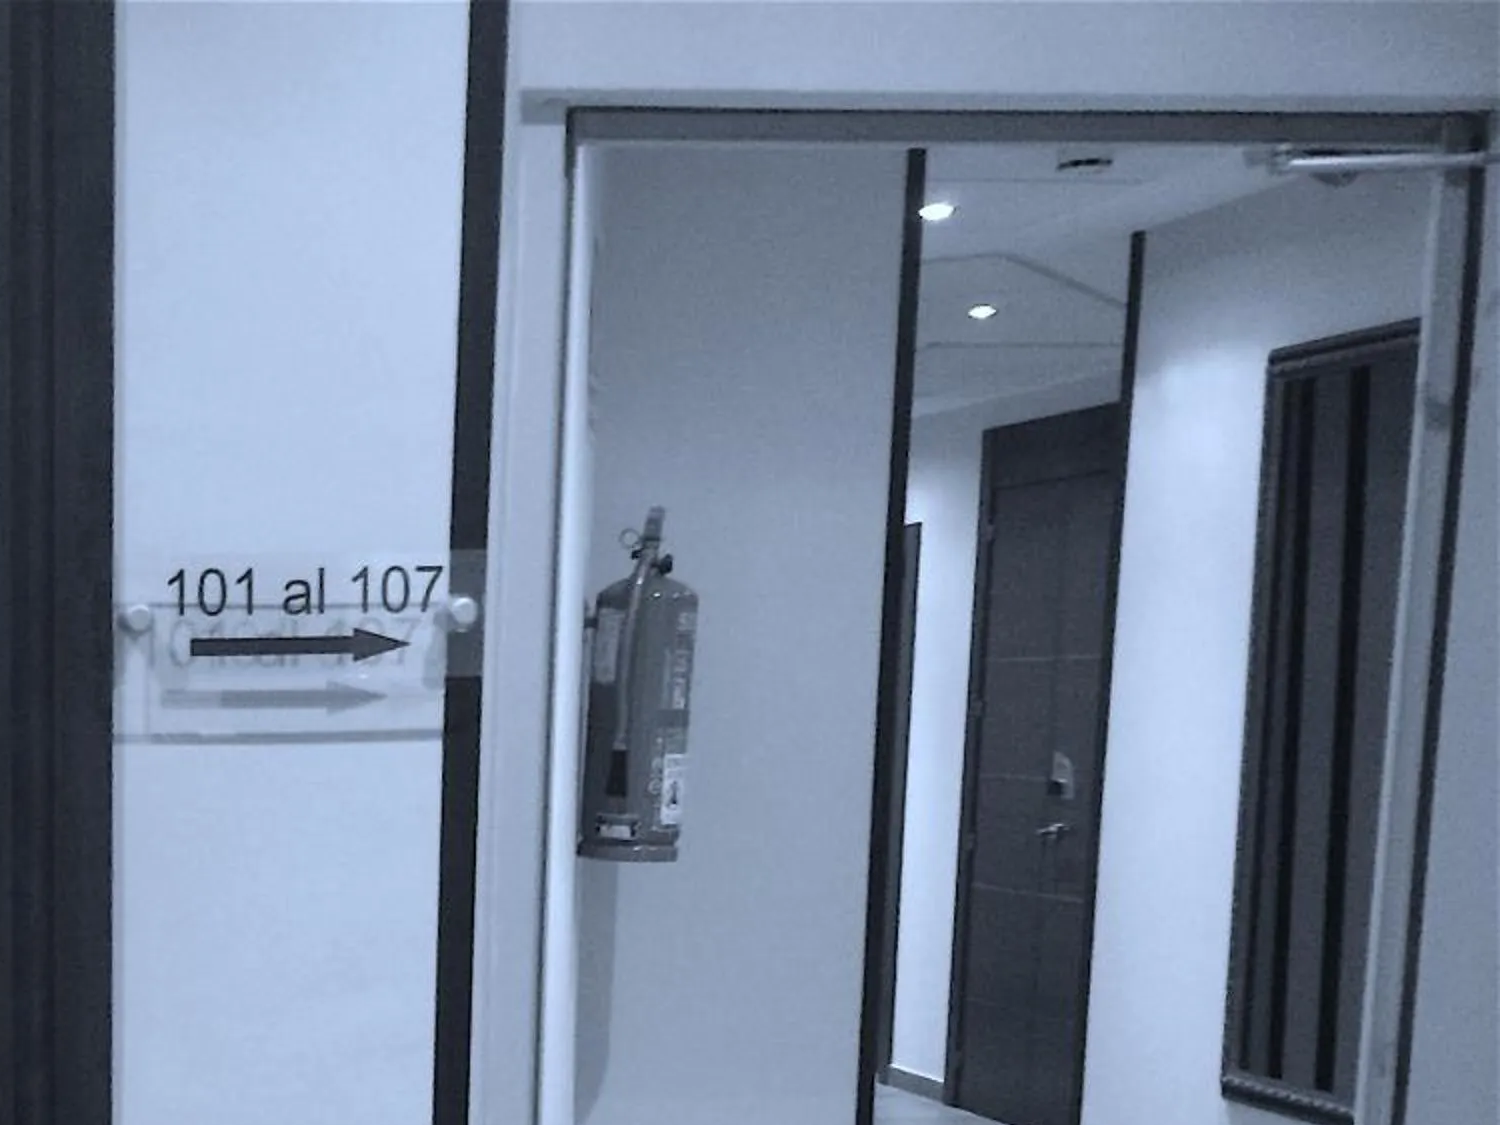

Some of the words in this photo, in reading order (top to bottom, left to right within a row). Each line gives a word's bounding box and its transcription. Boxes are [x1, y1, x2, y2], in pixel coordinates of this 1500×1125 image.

[167, 567, 254, 616] 101
[283, 567, 326, 615] al
[351, 565, 444, 613] 107
